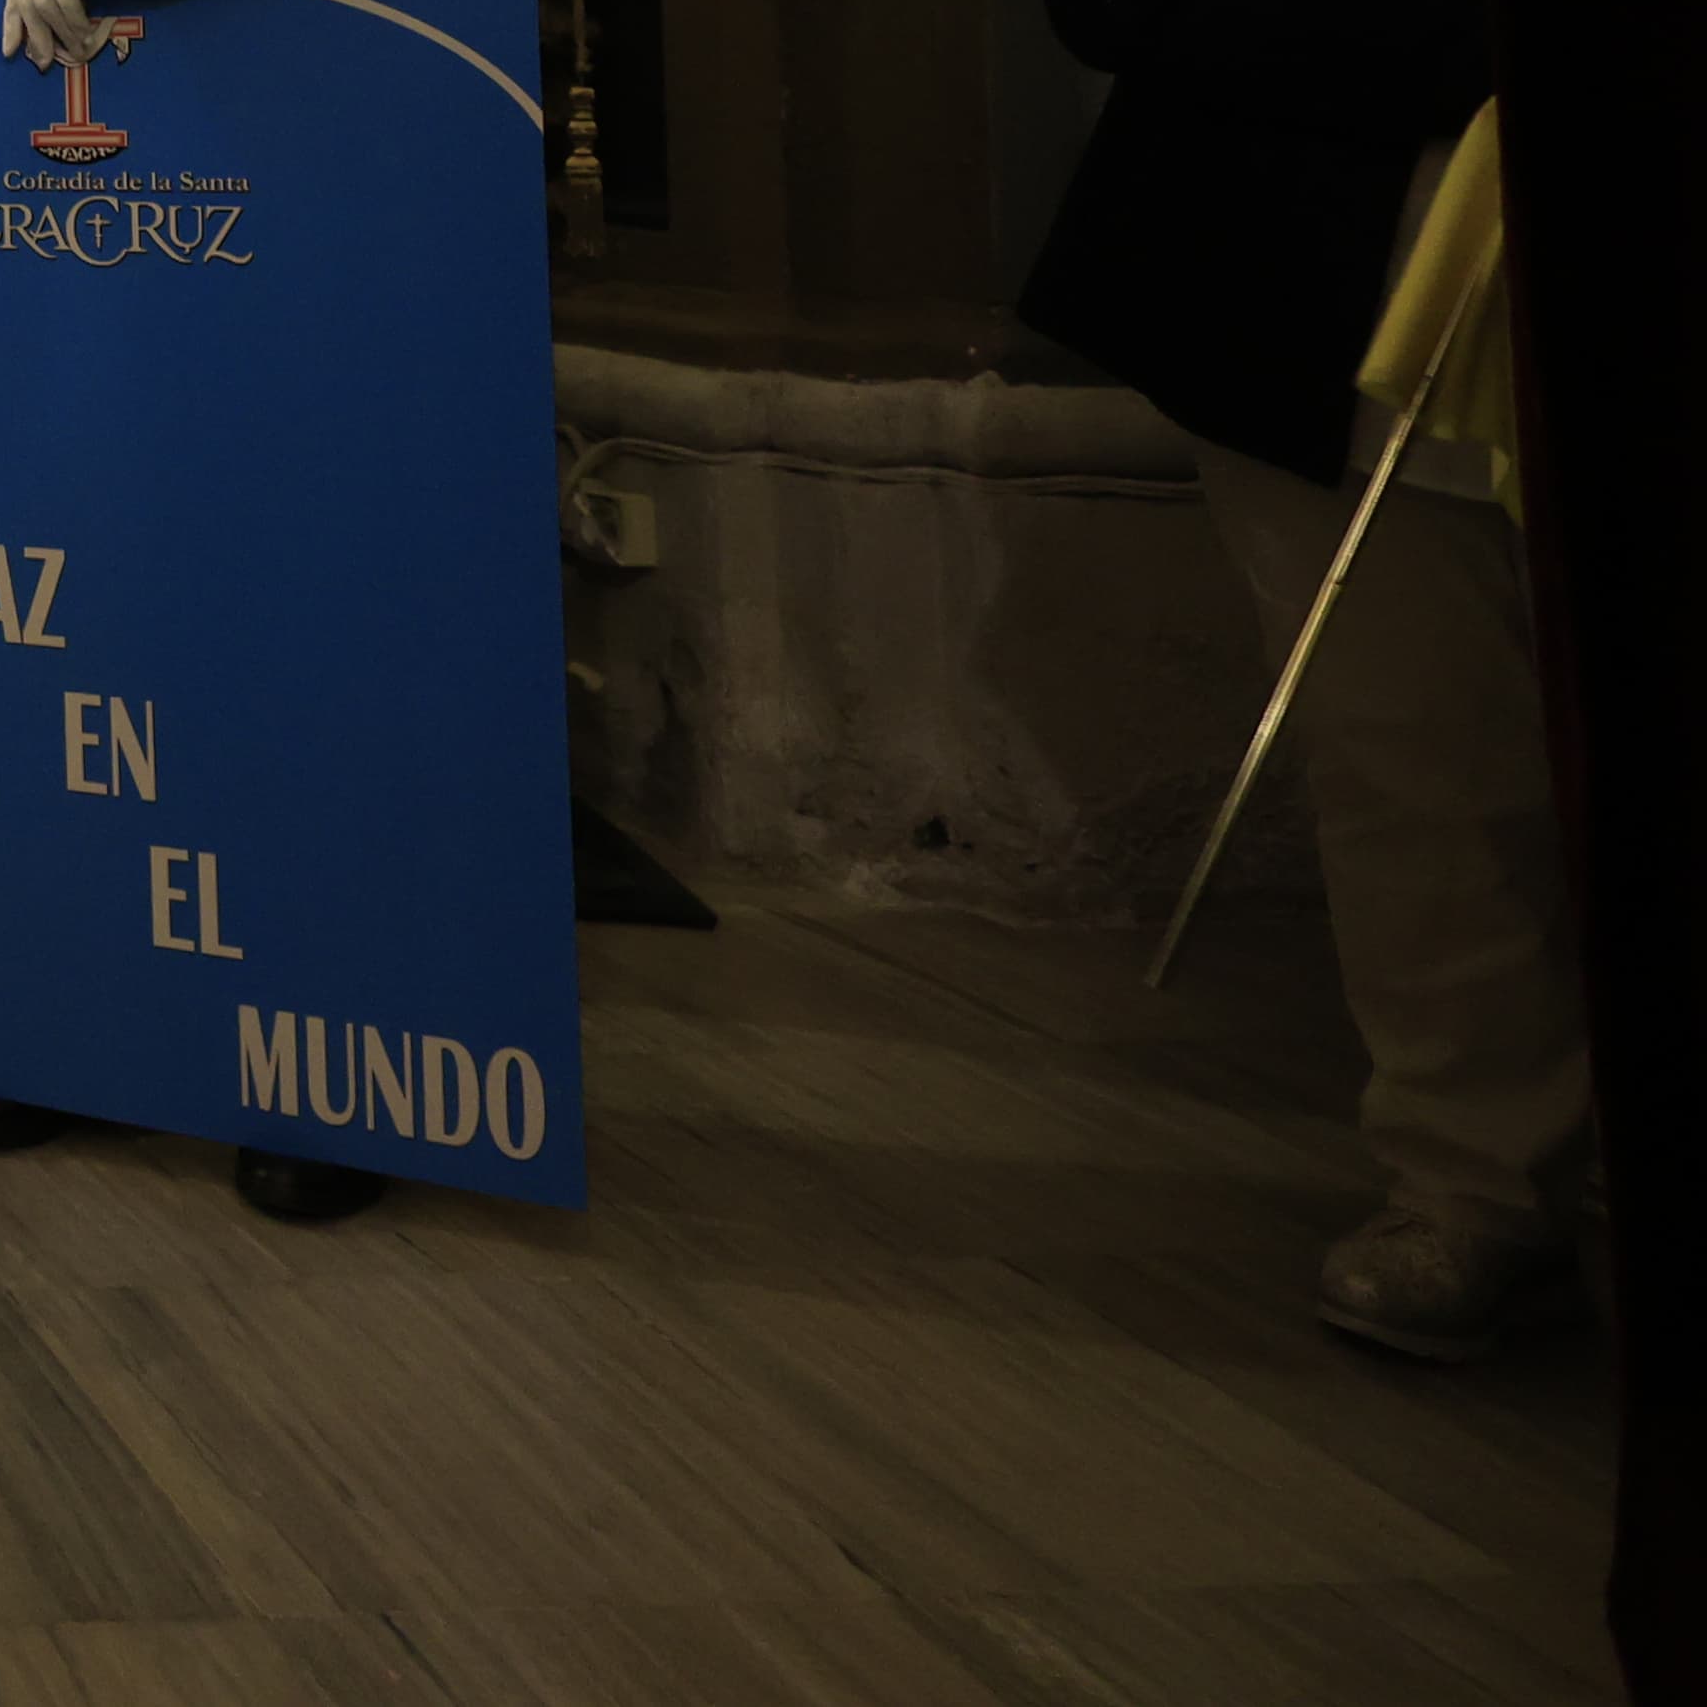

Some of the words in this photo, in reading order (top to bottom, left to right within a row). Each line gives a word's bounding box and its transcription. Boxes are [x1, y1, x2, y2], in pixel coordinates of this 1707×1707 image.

[2, 169, 105, 192] Cofradía
[113, 169, 144, 191] de
[150, 171, 172, 191] la
[179, 170, 250, 192] Santa
[64, 691, 157, 802] EN
[150, 844, 244, 961] EL
[237, 1004, 547, 1161] MUNDO
